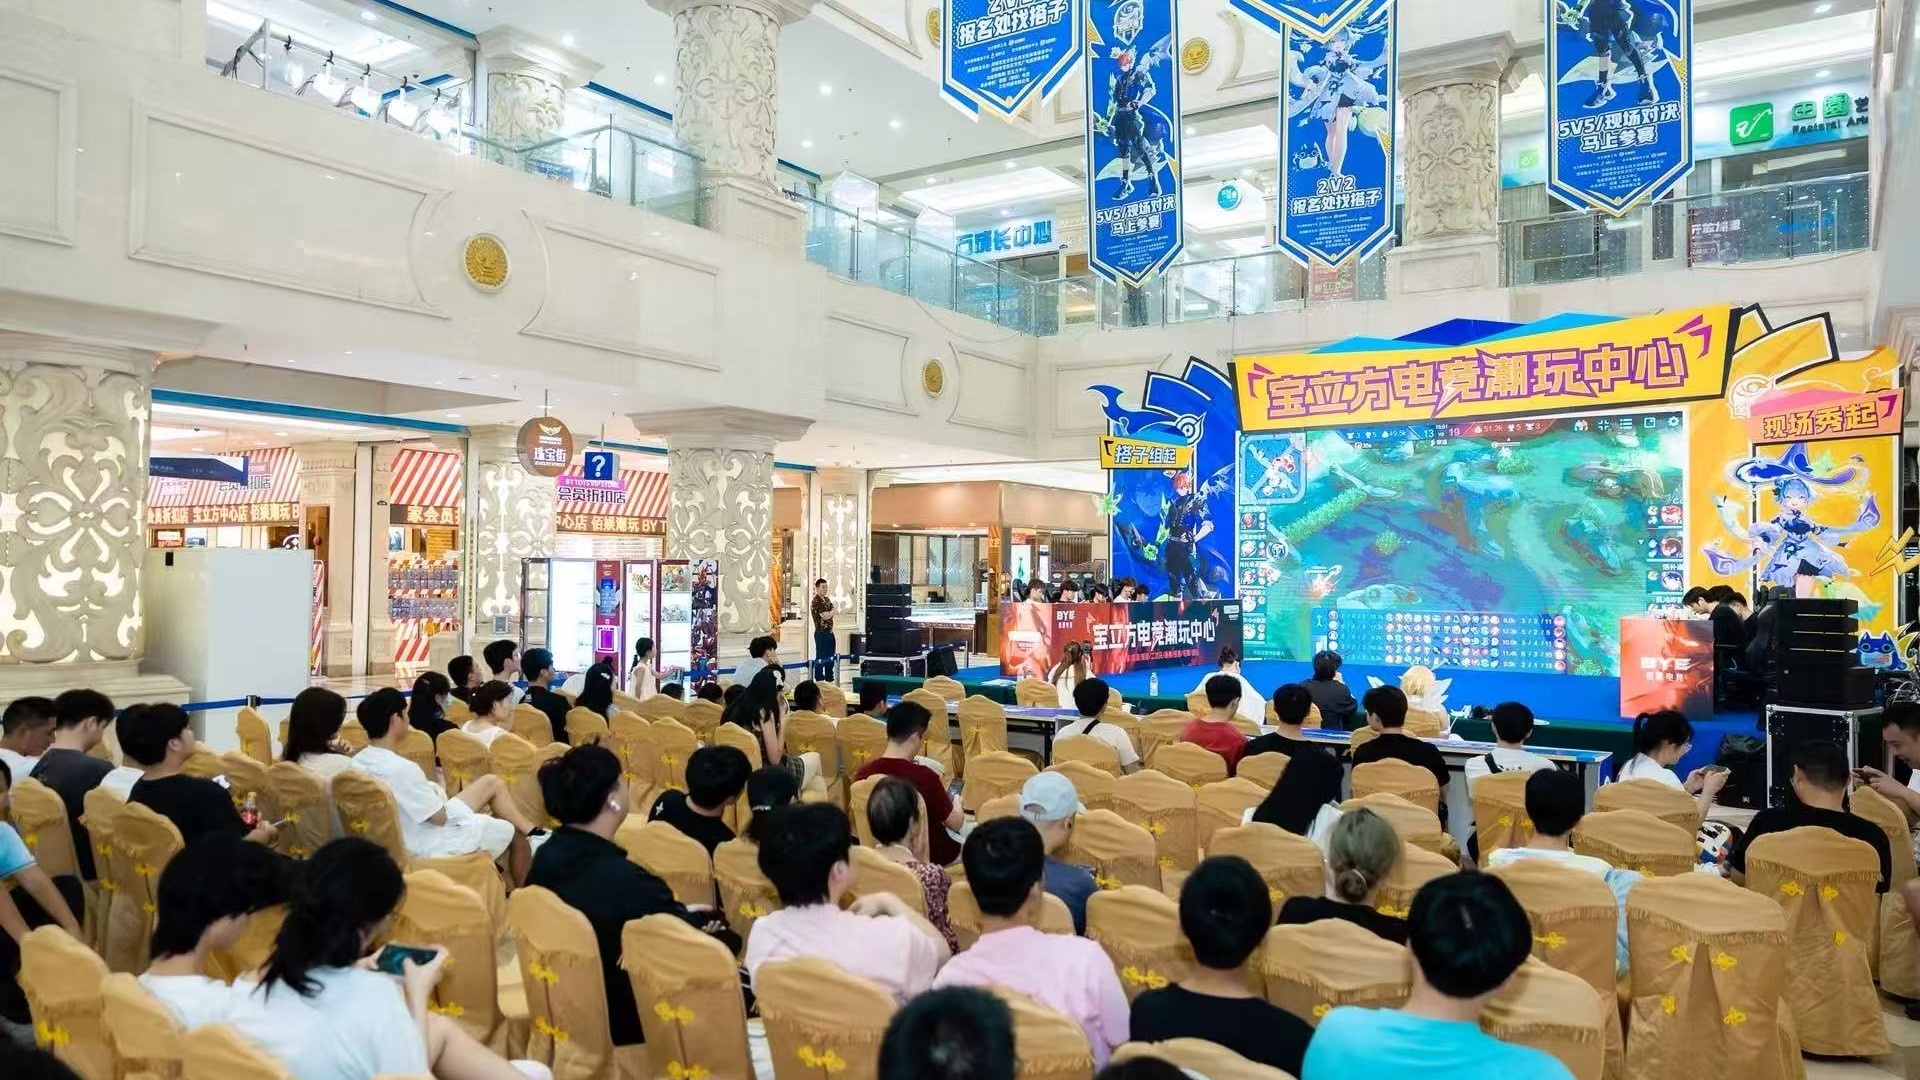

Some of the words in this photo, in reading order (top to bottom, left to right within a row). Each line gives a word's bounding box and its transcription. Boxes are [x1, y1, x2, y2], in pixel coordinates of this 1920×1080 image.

[959, 1, 1067, 46] 报名处找搭子
[1559, 103, 1679, 137] 5V5/现场对决
[1583, 126, 1655, 151] 马上参赛
[1318, 177, 1354, 194] 2V2
[1097, 196, 1175, 223] 5V5/现场对决
[1293, 190, 1380, 214] 报名处找搭子
[1113, 214, 1160, 235] 马上参赛
[1267, 337, 1688, 419] 宝立方电竞潮玩中心
[1449, 428, 1460, 436] 19
[1763, 401, 1878, 439] 现场秀起
[534, 447, 566, 462] 珠宝街
[1115, 444, 1176, 464] 搭子组起
[558, 486, 626, 503] 会员折扣店
[1093, 618, 1215, 651] 宝立方电竞潮玩中心
